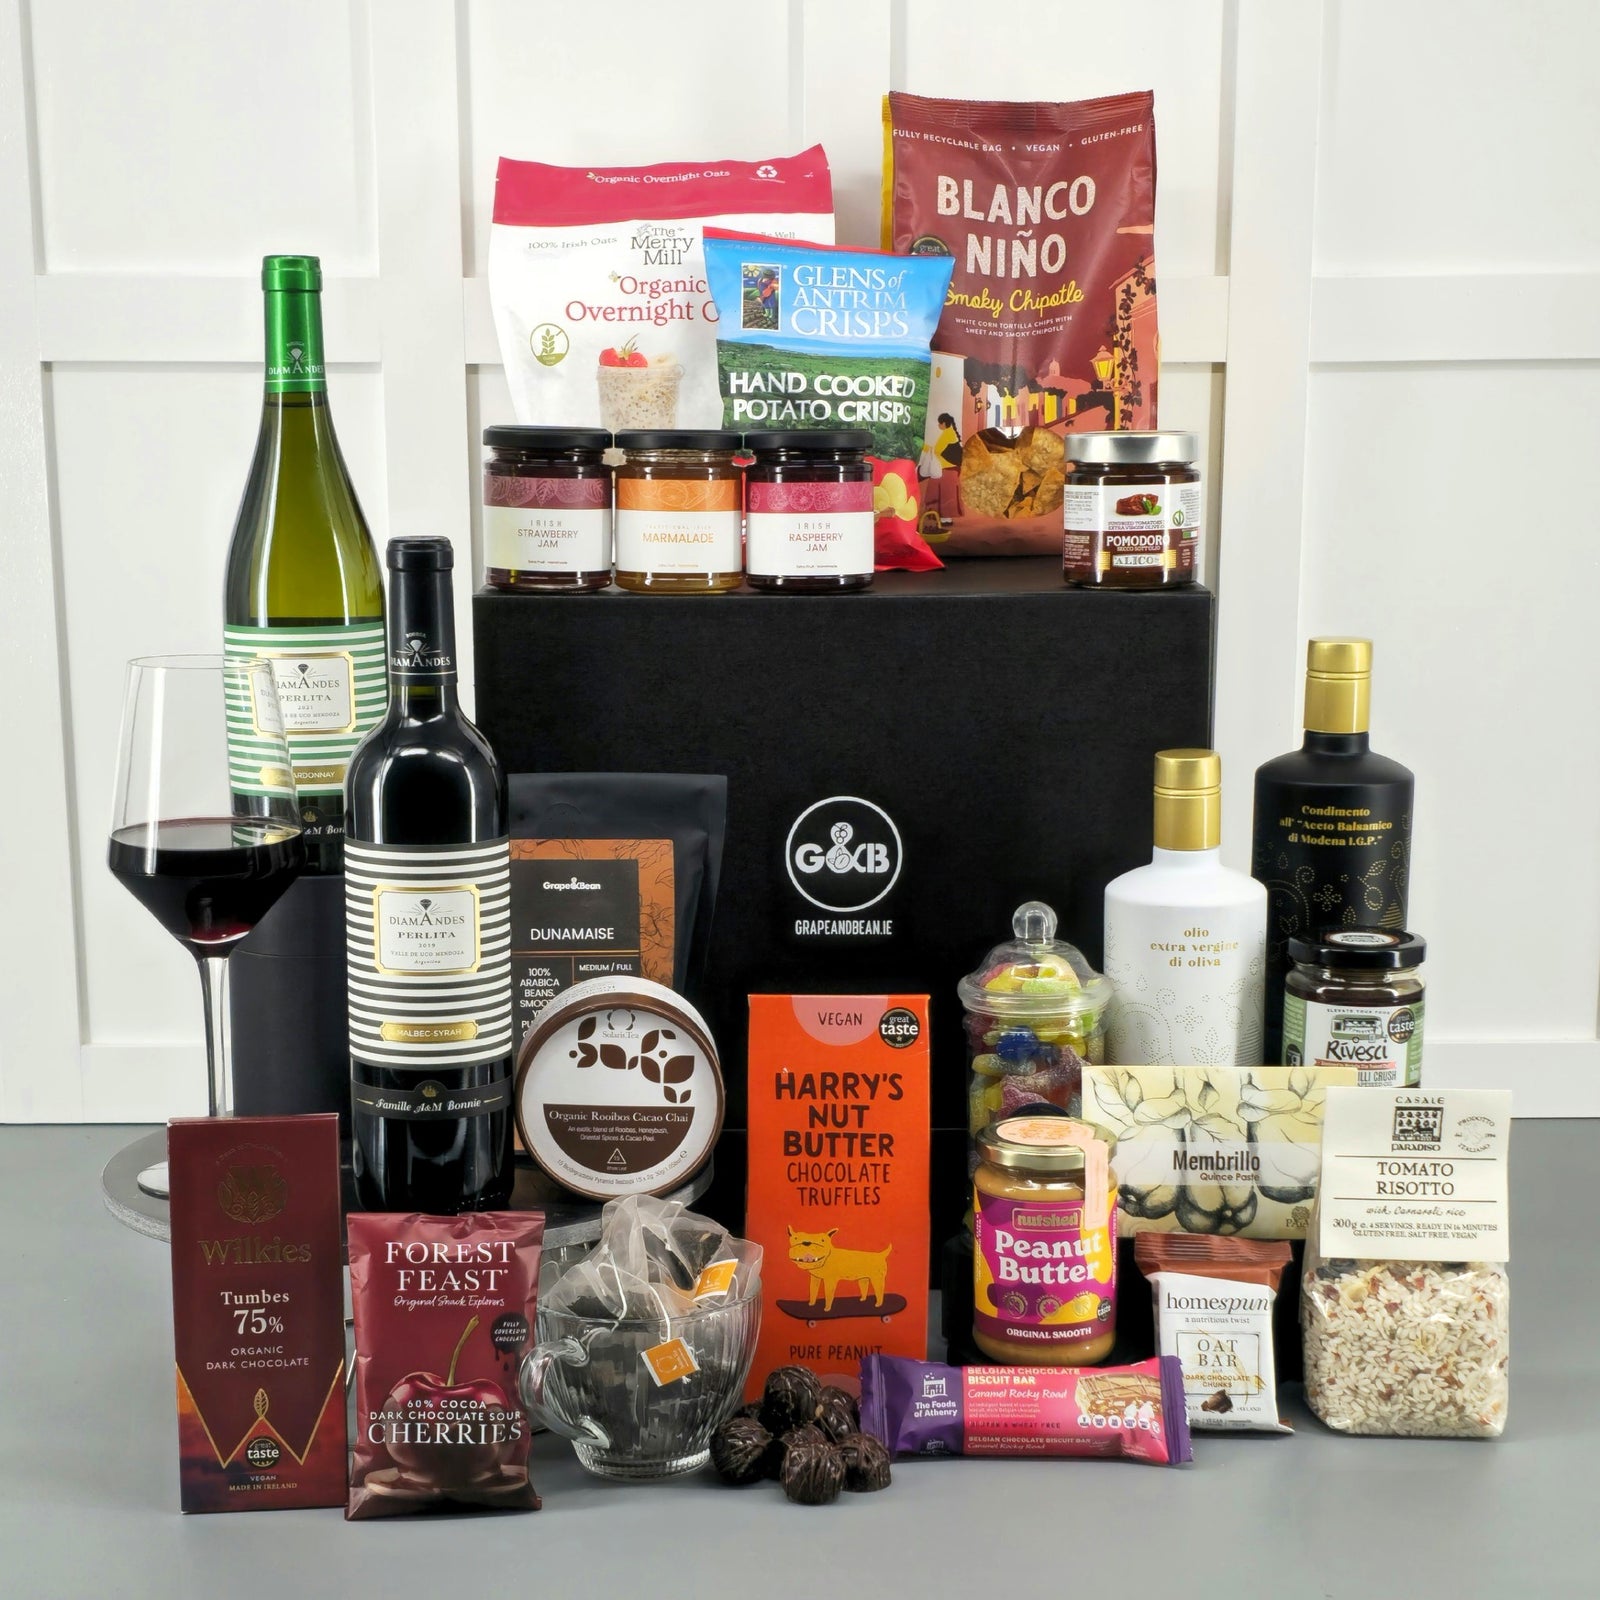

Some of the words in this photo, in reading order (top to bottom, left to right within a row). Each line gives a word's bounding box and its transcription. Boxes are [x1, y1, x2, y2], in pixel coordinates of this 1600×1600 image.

[893, 129, 920, 139] FULLY
[924, 134, 979, 150] RECYCLABLE
[983, 143, 1002, 152] BAG
[1081, 124, 1143, 145] GLUTEN-FREE
[595, 175, 640, 184] Organic
[643, 172, 701, 183] Overnight
[704, 169, 730, 178] Oats
[937, 175, 1096, 226] BLANCO
[652, 227, 675, 236] The
[528, 241, 558, 249] 100%
[562, 239, 588, 248] Irish
[591, 236, 617, 246] Oats
[631, 236, 694, 252] Merry
[643, 250, 682, 265] Mill
[967, 229, 1066, 278] NIÑO
[793, 266, 885, 289] GLENS
[888, 271, 906, 289] of
[619, 276, 706, 301] Organic
[792, 289, 906, 309] ANTRIM
[944, 281, 1003, 318] Smoky
[1010, 281, 1084, 317] Chipotle
[565, 300, 694, 326] Overnight
[790, 309, 909, 337] CRISPS
[956, 317, 974, 326] WHITE
[1034, 318, 1054, 326] CHIPS
[1055, 315, 1073, 323] WITH
[966, 327, 987, 336] SWEET
[1005, 330, 1030, 338] SMOKY
[1032, 325, 1064, 335] CHIPOTLE
[730, 372, 807, 394] HAND
[814, 375, 915, 398] COOKED
[733, 399, 831, 421] POTATO
[838, 401, 911, 425] CRISPS
[798, 522, 831, 530] IRISH
[518, 529, 578, 539] STRAWBERRY
[642, 532, 714, 543] MARMALADE
[789, 532, 844, 542] RASPBERRY
[1106, 535, 1170, 546] POMODORO
[538, 540, 558, 548] JAM
[806, 543, 828, 552] JAM
[1302, 806, 1370, 816] Condimento
[1338, 821, 1392, 831] Balsamico
[1301, 835, 1345, 846] Modena
[390, 913, 465, 925] DIAMANDES
[530, 928, 614, 940] DUNAMAISE
[795, 920, 892, 935] GRAPEANDBEAN.IE
[1184, 928, 1209, 937] olio
[398, 931, 456, 939] PERLITA
[1150, 942, 1185, 951] extra
[1192, 941, 1238, 954] vergine
[1169, 957, 1182, 967] di
[1188, 957, 1220, 967] oliva
[528, 968, 551, 976] 100%
[524, 989, 555, 997] BEANS.
[818, 1012, 863, 1026] VEGAN
[890, 1016, 909, 1024] great
[397, 1029, 461, 1037] MALBEC-SYRAH
[881, 1023, 918, 1035] taste
[1390, 1022, 1414, 1033] taste
[1374, 1071, 1396, 1081] CRUSH
[775, 1072, 903, 1100] HARRY'S
[376, 1098, 410, 1111] Famille
[447, 1099, 481, 1111] Bonnie
[1396, 1096, 1444, 1104] CASALE
[549, 1111, 588, 1121] Organic
[592, 1112, 630, 1121] Rooibos
[633, 1114, 662, 1122] Cacao
[665, 1112, 688, 1122] Chai
[809, 1104, 870, 1128] NUT
[784, 1131, 894, 1157] BUTTER
[1391, 1144, 1440, 1152] PARADISO
[1173, 1150, 1260, 1171] Membrillo
[787, 1163, 891, 1183] CHOCOLATE
[1377, 1162, 1454, 1176] TOMATO
[1200, 1173, 1234, 1181] Quince
[1235, 1173, 1260, 1181] Paste
[1377, 1181, 1455, 1195] RISOTTO
[797, 1187, 881, 1206] TRUFFLES
[1394, 1206, 1443, 1216] Carnaroli
[1018, 1213, 1078, 1226] nutshed
[1333, 1219, 1357, 1229] 300g
[1451, 1231, 1477, 1239] VEGAN
[198, 1236, 312, 1265] Wilkies
[995, 1229, 1102, 1259] Peanut
[384, 1242, 515, 1264] FOREST
[999, 1256, 1099, 1285] Butter
[397, 1269, 503, 1291] FEAST
[221, 1290, 290, 1305] Tumbes
[394, 1295, 436, 1311] Original
[437, 1295, 466, 1307] Snack
[468, 1295, 504, 1308] Explorers
[1167, 1292, 1269, 1314] homespun
[233, 1308, 284, 1335] 75%
[1006, 1328, 1051, 1339] ORIGINAL
[1053, 1327, 1091, 1338] SMOOTH
[231, 1346, 283, 1356] ORGANIC
[1198, 1339, 1237, 1352] OAT
[790, 1345, 822, 1360] PURE
[828, 1346, 882, 1360] PEANUT
[207, 1361, 236, 1370] DARK
[241, 1358, 309, 1368] CHOCOLATE
[1198, 1354, 1237, 1367] BAR
[968, 1376, 1010, 1385] BISCUIT
[1013, 1376, 1035, 1384] BAR
[968, 1389, 1007, 1399] Caramel
[1009, 1389, 1039, 1399] Rocky
[1042, 1389, 1067, 1398] Road
[407, 1400, 434, 1408] 60%
[440, 1401, 486, 1409] COCOA
[915, 1401, 930, 1409] The
[370, 1412, 403, 1420] DARK
[409, 1412, 484, 1421] CHOCOLATE
[490, 1411, 521, 1420] SOUR
[924, 1409, 958, 1418] Athenry
[368, 1422, 521, 1445] CHERRIES
[247, 1448, 279, 1459] taste
